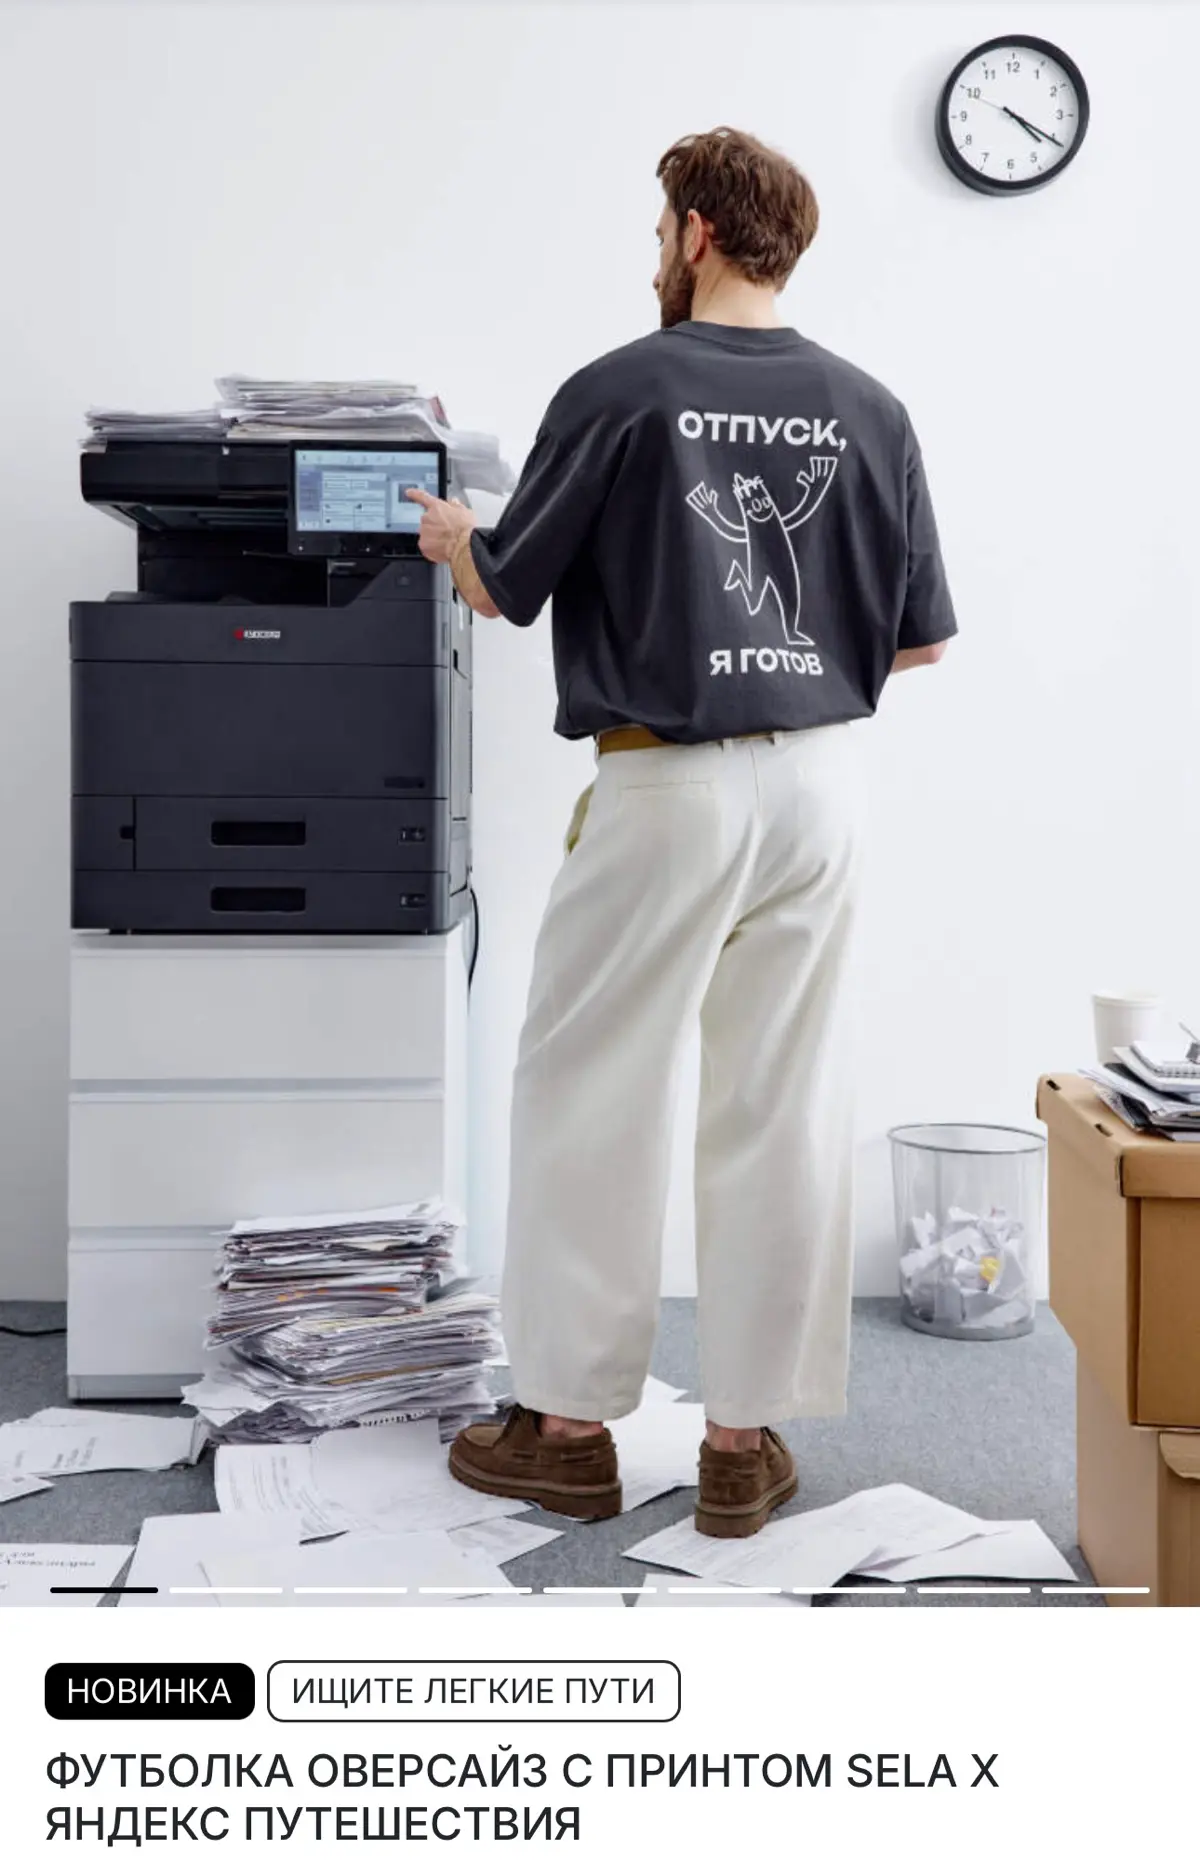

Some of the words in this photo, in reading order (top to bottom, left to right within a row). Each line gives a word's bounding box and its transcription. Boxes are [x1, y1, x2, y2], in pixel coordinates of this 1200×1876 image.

[1005, 61, 1021, 74] 12
[984, 69, 996, 80] 11
[966, 87, 982, 100] 10
[1050, 86, 1058, 98] 2
[960, 110, 968, 122] 9
[1056, 109, 1064, 121] 3
[964, 134, 973, 146] 8
[981, 152, 990, 163] 7
[1030, 151, 1039, 164] 5
[1006, 158, 1015, 170] 6
[678, 410, 847, 451] ОТПУСК,
[709, 649, 732, 676] Я
[739, 647, 824, 676] ГОТОВ
